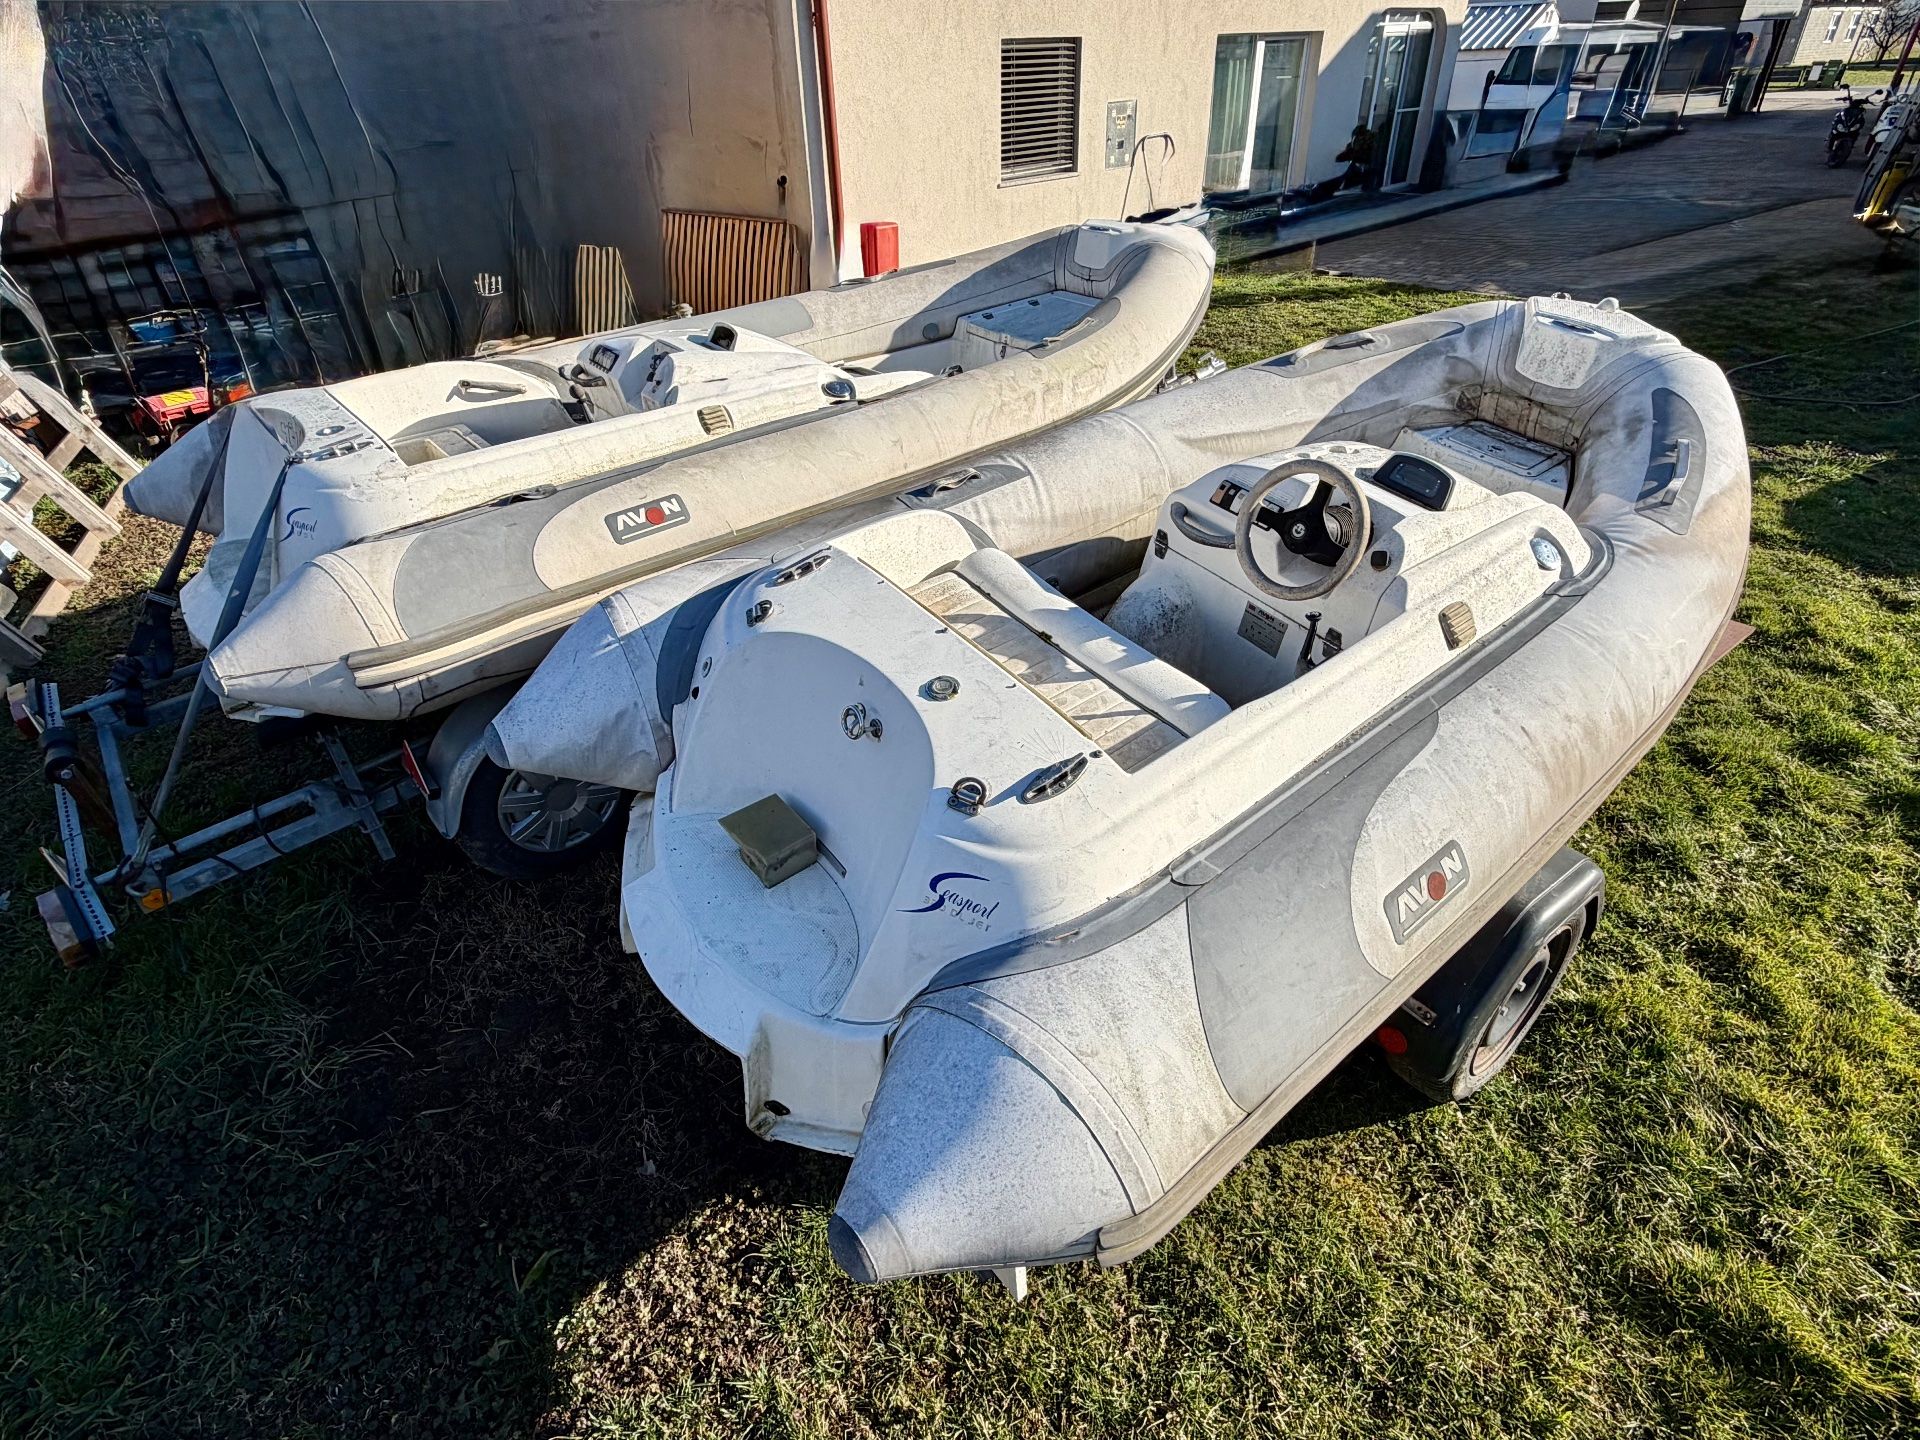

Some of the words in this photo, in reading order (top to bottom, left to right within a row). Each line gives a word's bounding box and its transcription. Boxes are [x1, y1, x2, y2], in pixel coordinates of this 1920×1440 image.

[616, 497, 682, 531] AVON
[896, 872, 1000, 920] Seasport
[1397, 848, 1463, 924] AVON
